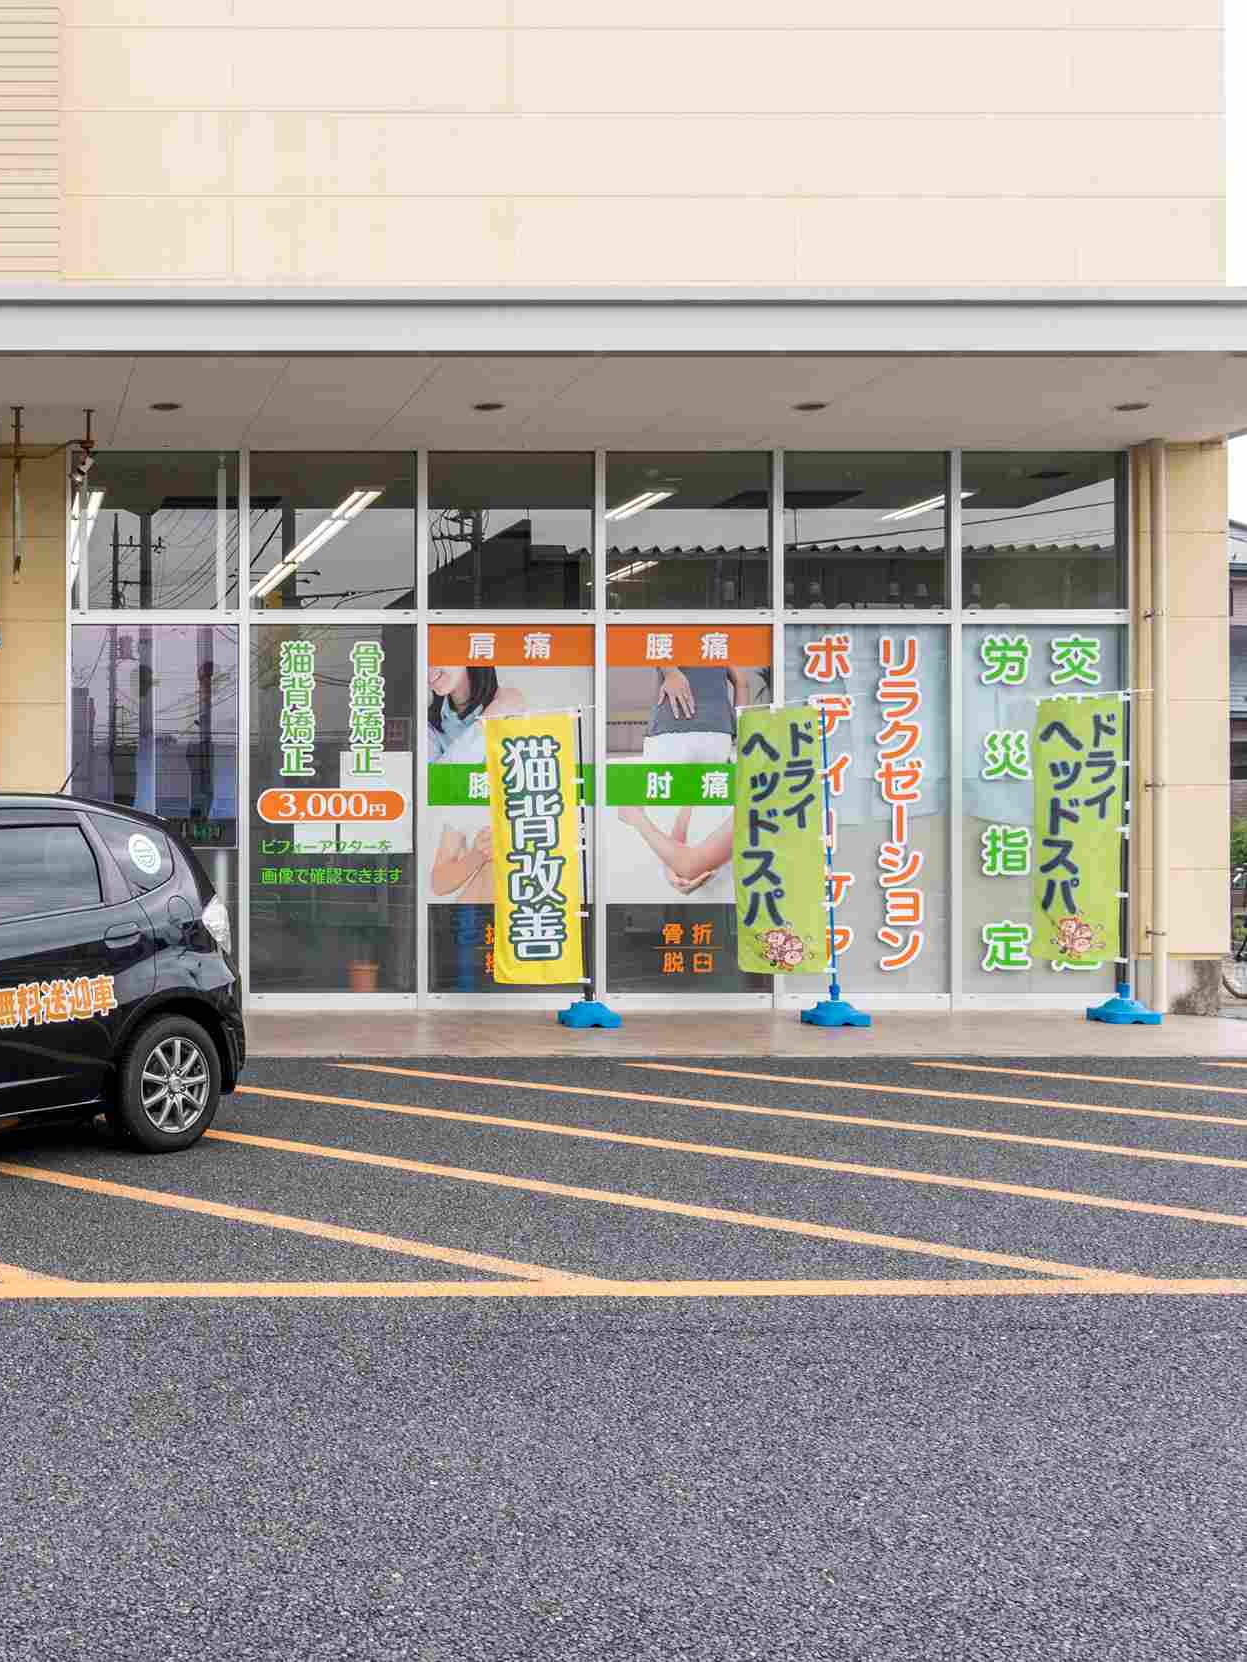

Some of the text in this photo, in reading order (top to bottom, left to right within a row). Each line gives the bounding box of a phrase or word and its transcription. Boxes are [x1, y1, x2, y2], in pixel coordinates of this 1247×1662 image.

[468, 633, 551, 660] 肩痛
[646, 632, 729, 660] 腰痛
[279, 641, 315, 777] 猫背矯正
[349, 641, 385, 777] 骨盤矯正
[277, 792, 387, 821] 3,000円
[646, 771, 730, 799] 肘痛
[783, 720, 815, 830] ドライ
[980, 633, 1033, 972] 労災指定
[1039, 720, 1083, 914] ヘッドスパ
[1083, 713, 1117, 820] ドライ
[261, 867, 402, 885] 画像で確認できます
[501, 735, 567, 963] 猫背改善
[741, 732, 785, 927] ヘッドスパ
